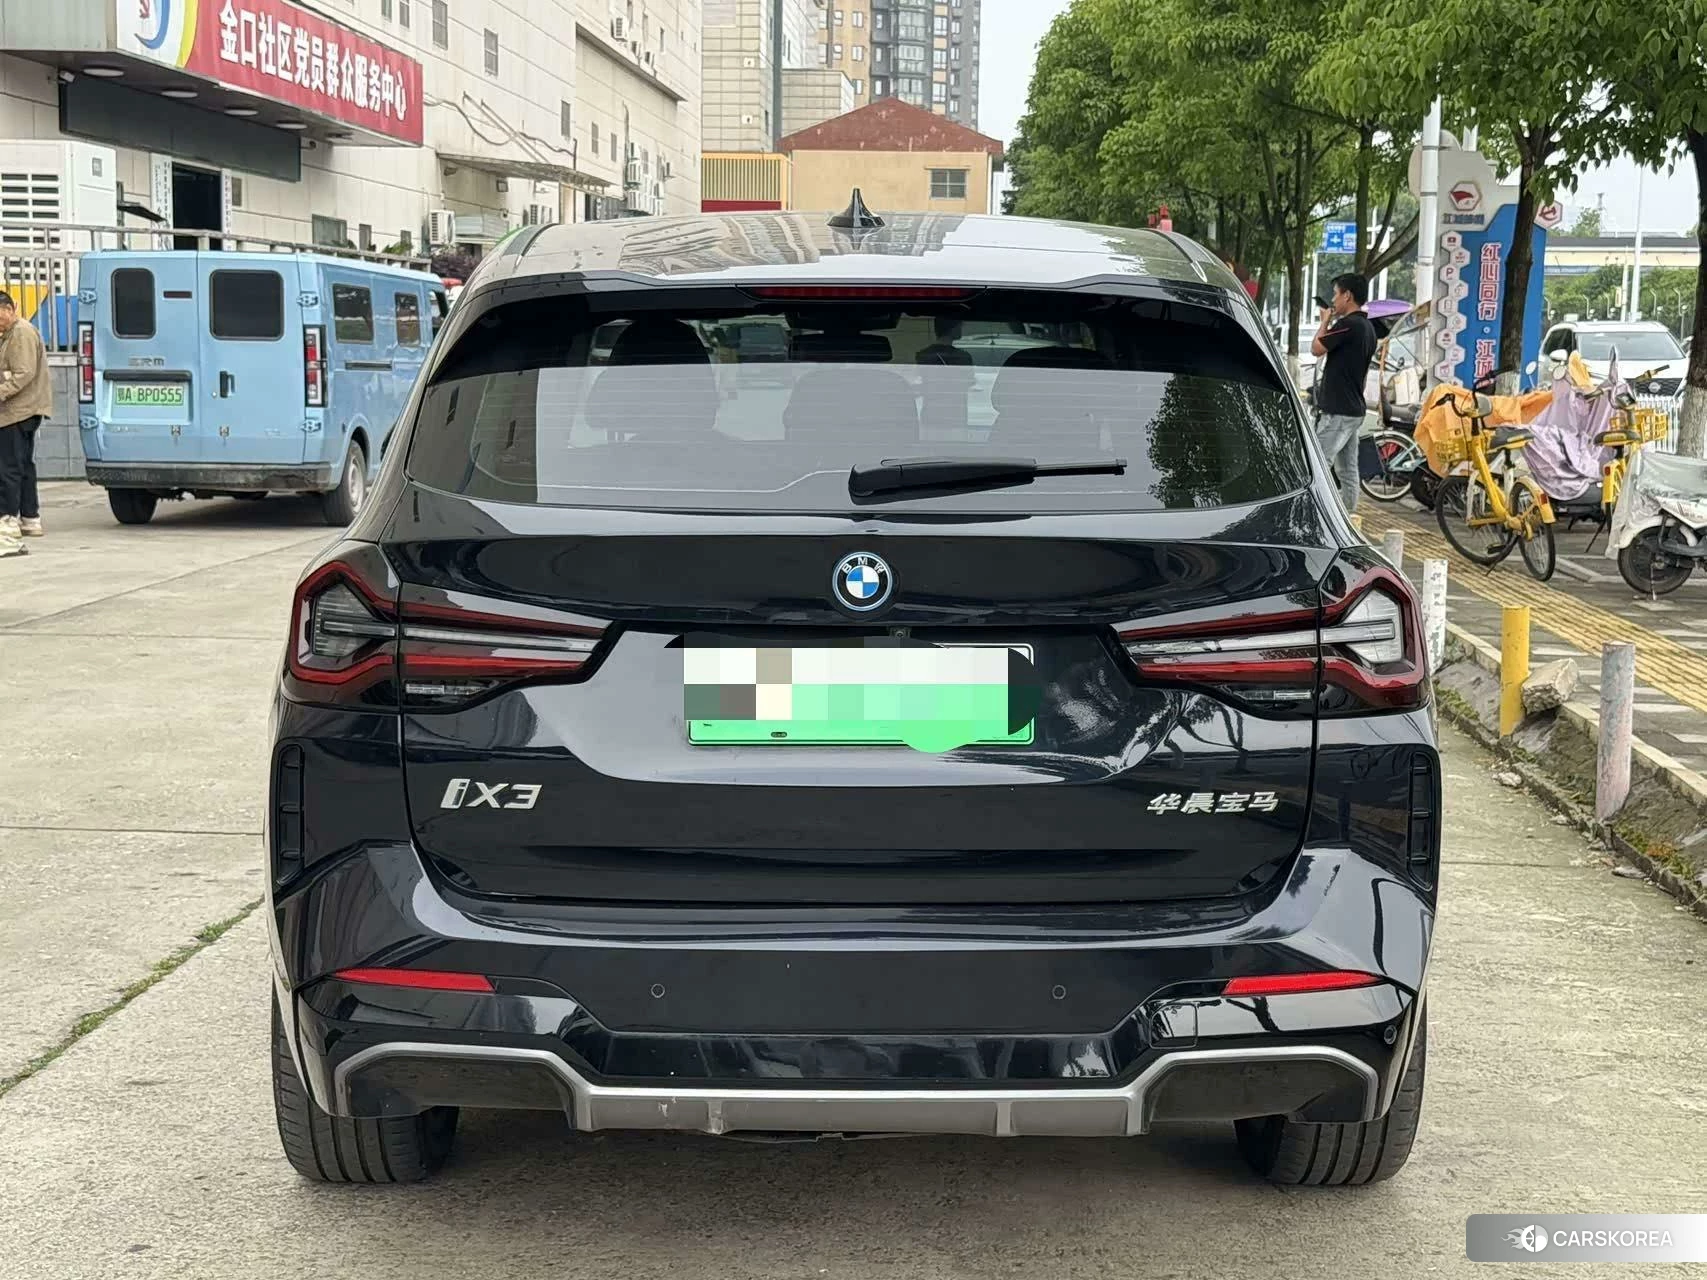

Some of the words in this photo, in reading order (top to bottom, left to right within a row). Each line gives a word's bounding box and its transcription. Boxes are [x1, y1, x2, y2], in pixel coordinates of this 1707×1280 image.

[220, 0, 407, 121] 金口社区党员群众服务中心
[841, 556, 886, 574] BMW
[1147, 792, 1279, 815] 华晨宝马
